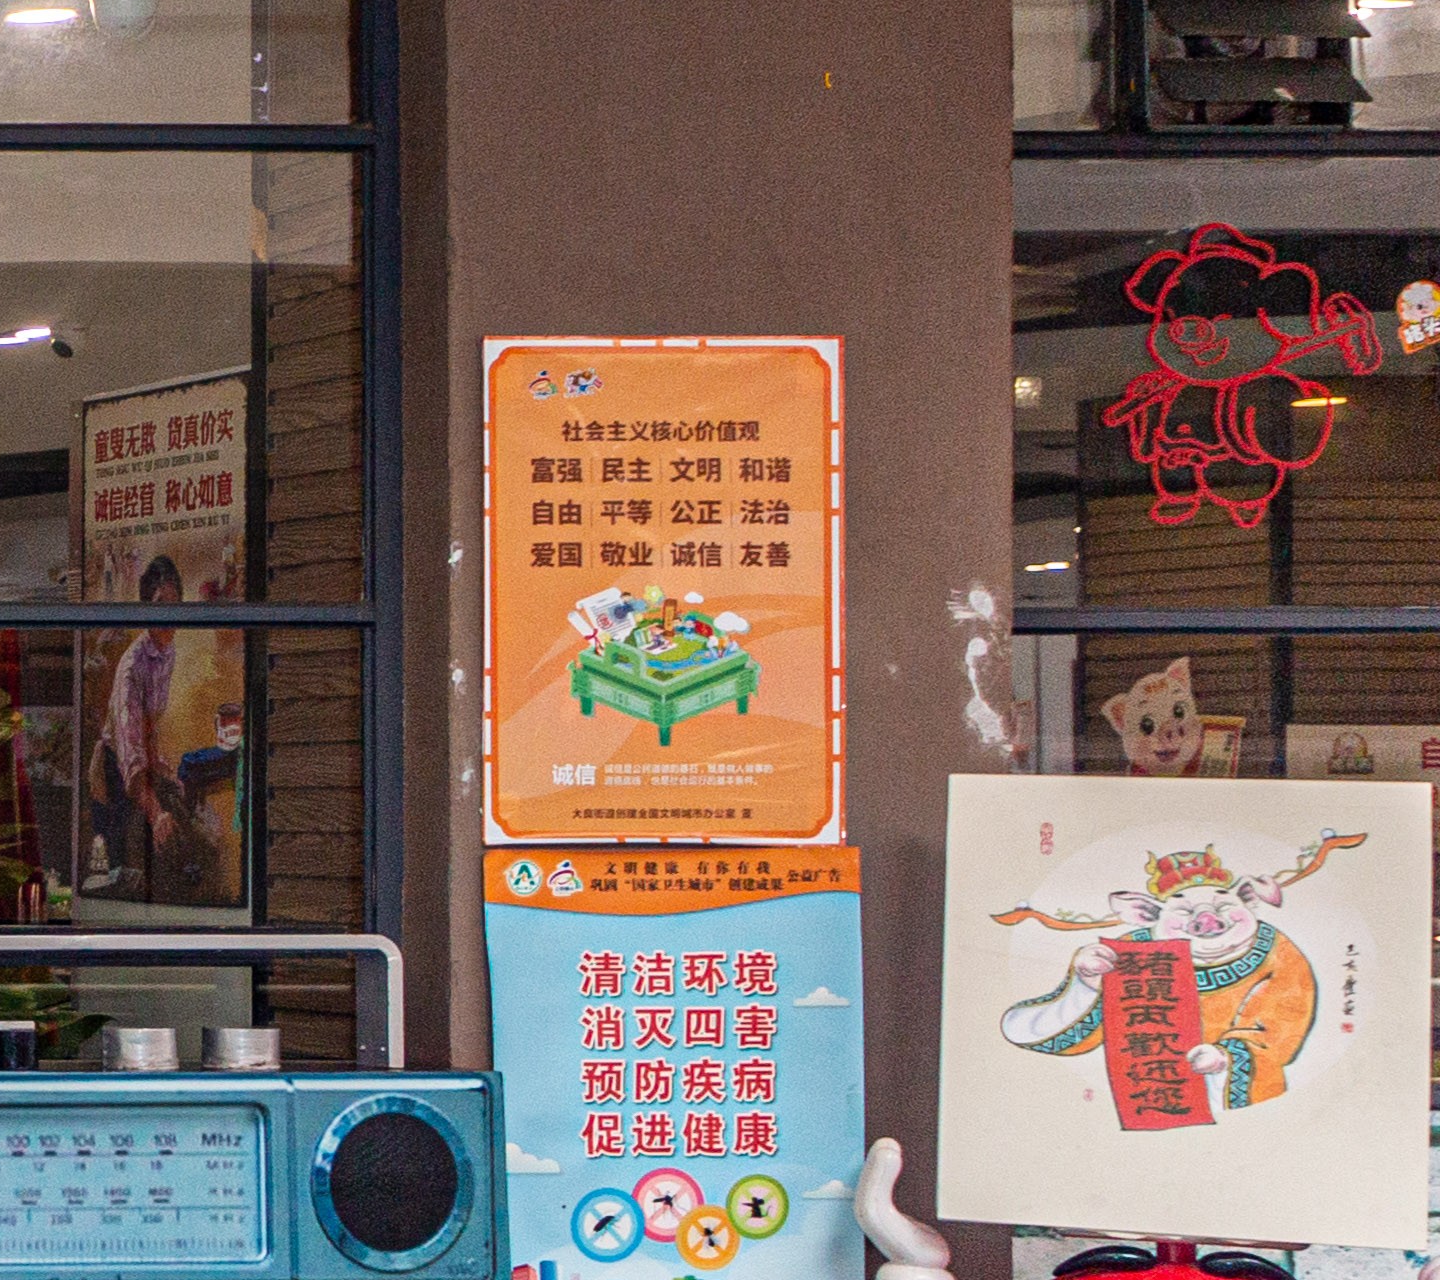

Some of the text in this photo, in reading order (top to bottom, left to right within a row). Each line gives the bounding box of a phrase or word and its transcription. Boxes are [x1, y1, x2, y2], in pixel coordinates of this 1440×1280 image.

[94, 408, 234, 464] 童叟无欺 货真价实
[562, 420, 760, 442] 社会主义核心价值观
[530, 457, 792, 484] 富强 民主 文明 和谐
[94, 471, 233, 522] 诚信经营 称心如意
[531, 499, 791, 525] 自由 平等 公正 法治
[530, 541, 792, 568] 爱国 敬业 诚信 友善
[552, 763, 597, 786] 诚信
[579, 950, 778, 996] 清洁环境
[581, 1005, 778, 1050] 消灭四害
[581, 1058, 776, 1104] 预防疾病
[581, 1111, 778, 1157] 促进健康
